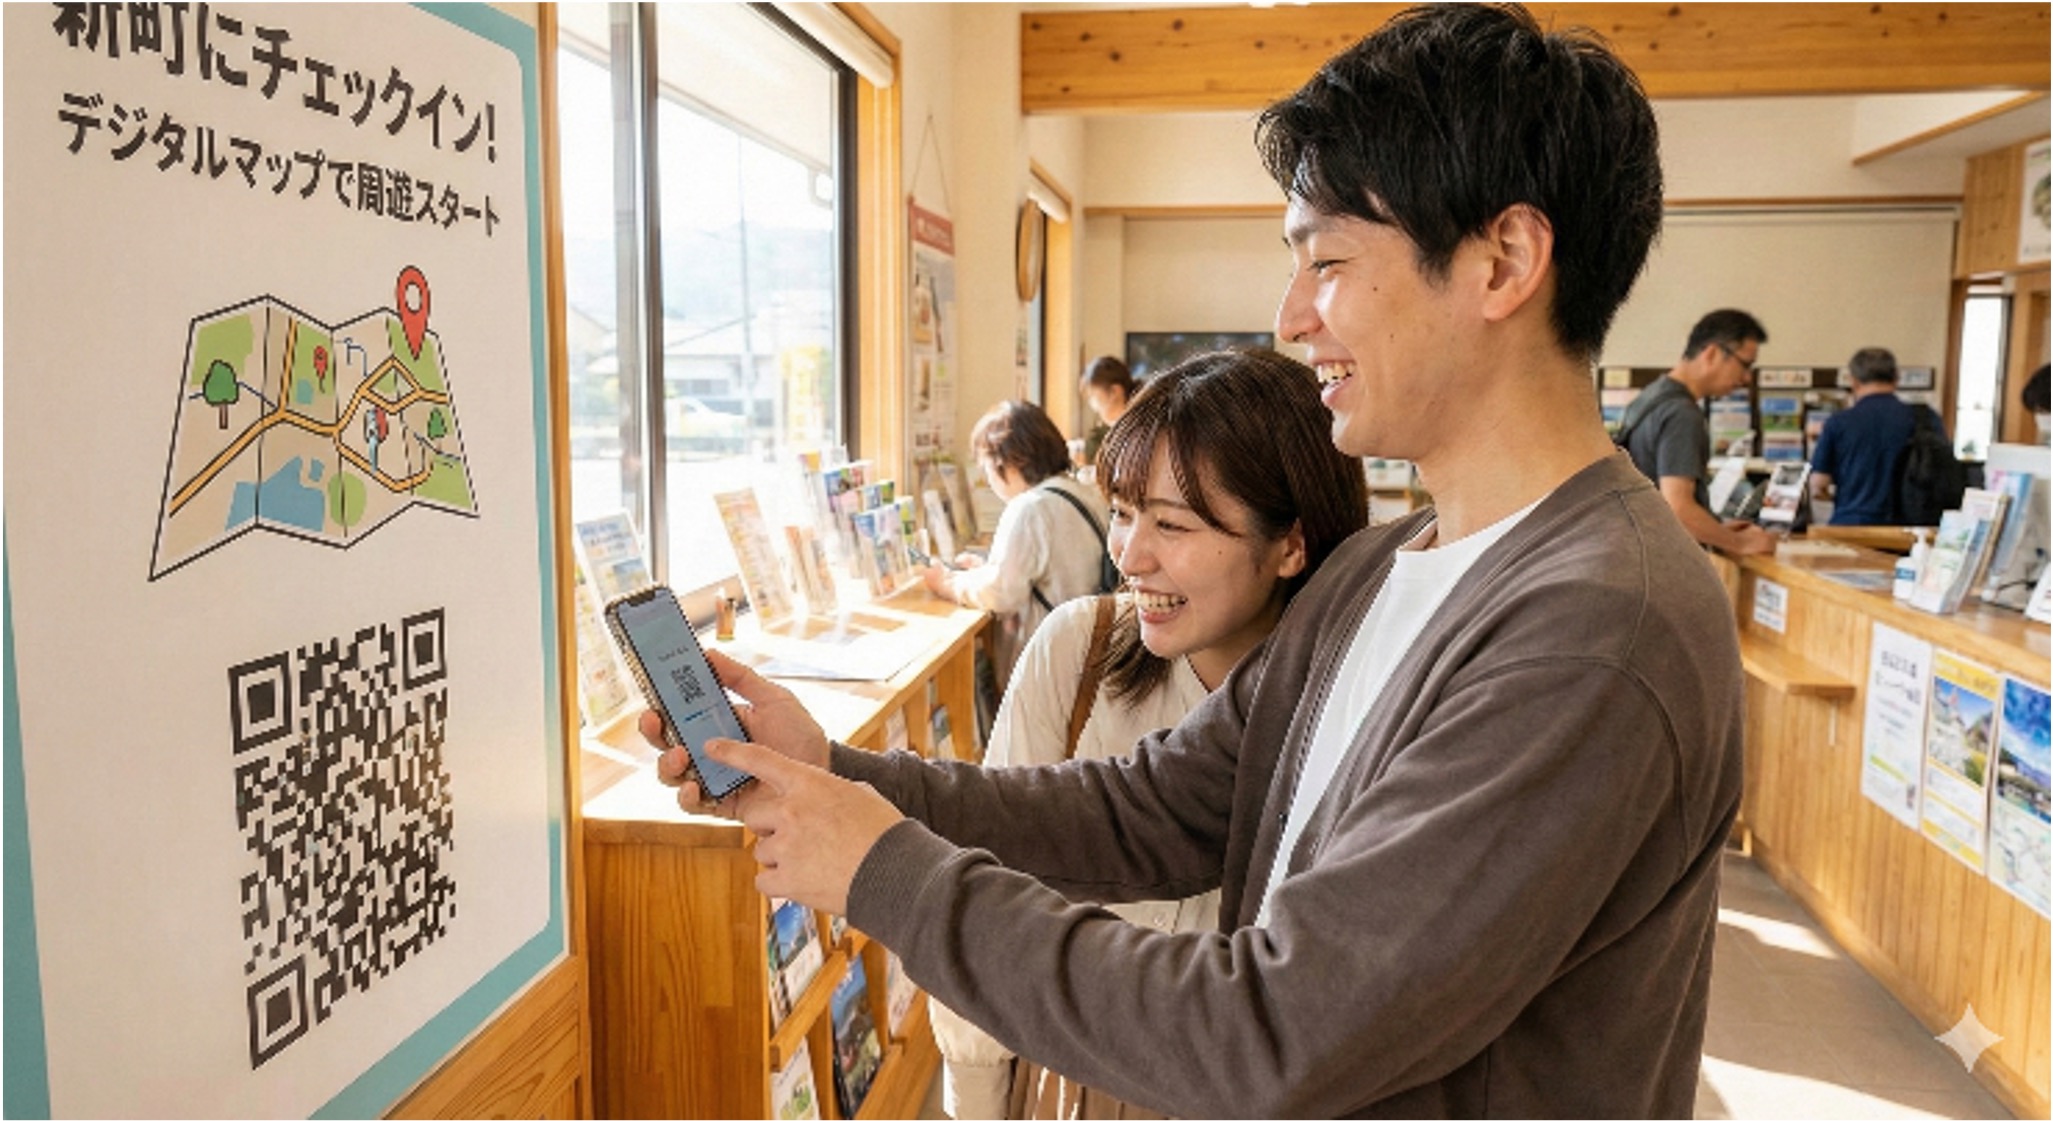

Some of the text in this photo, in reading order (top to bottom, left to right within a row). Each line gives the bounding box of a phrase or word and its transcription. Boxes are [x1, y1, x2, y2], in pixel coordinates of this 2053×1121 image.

[57, 93, 500, 237] デジタルマップで周遊スタート
